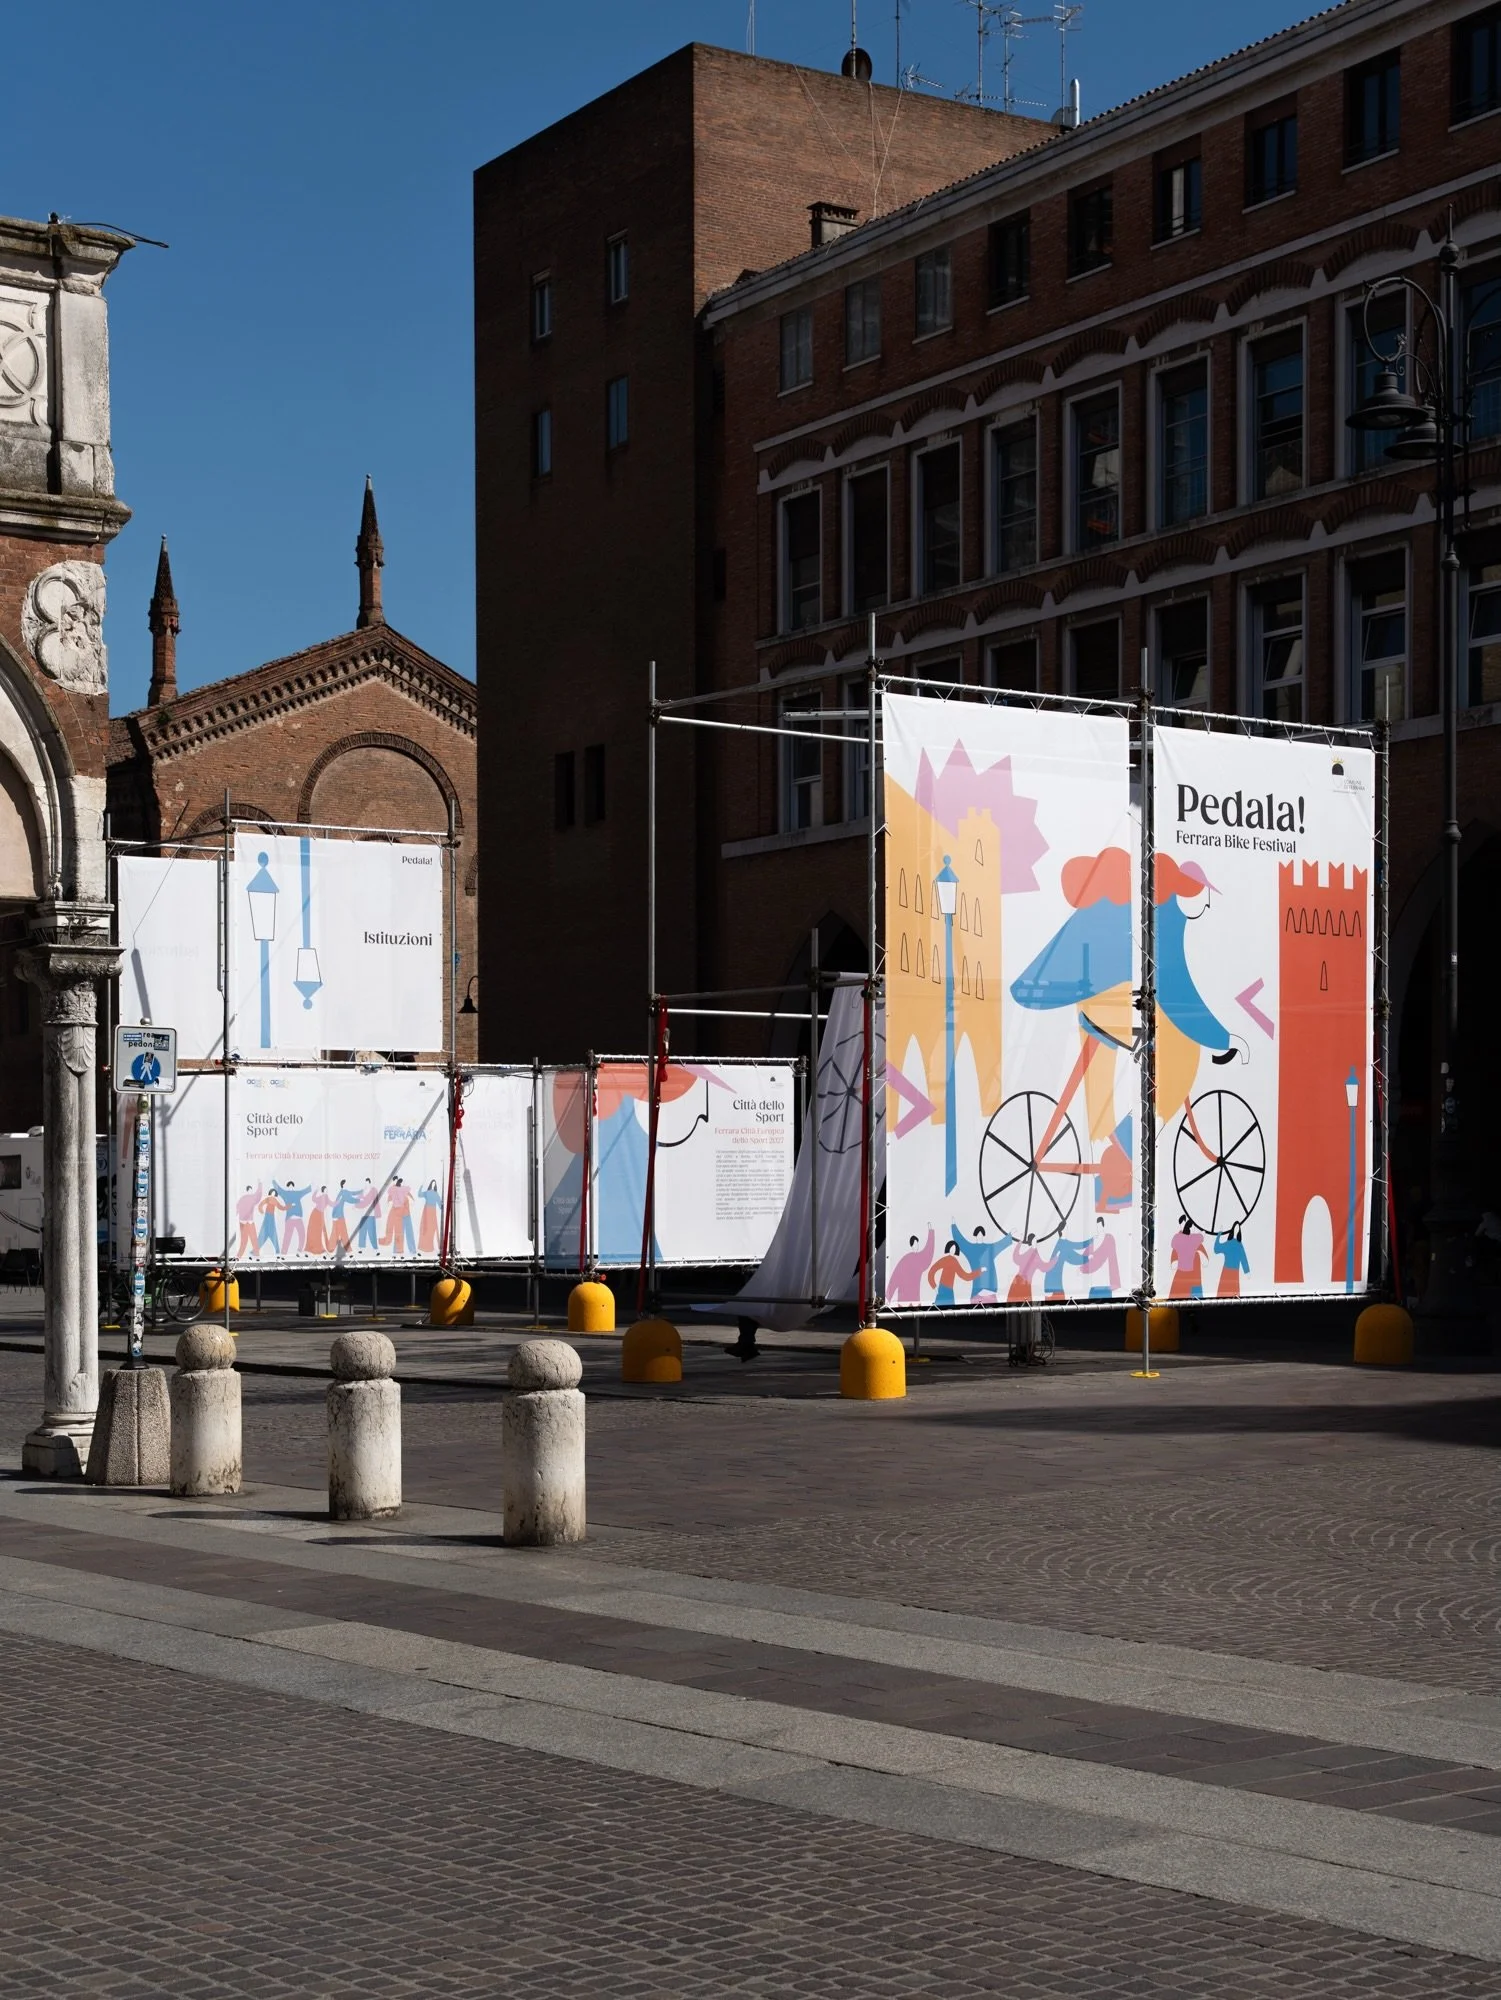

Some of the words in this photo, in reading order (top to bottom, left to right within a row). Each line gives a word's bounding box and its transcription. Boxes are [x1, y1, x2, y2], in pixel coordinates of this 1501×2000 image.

[1177, 784, 1305, 834] Pedala!
[1176, 830, 1221, 847] Ferrara
[1224, 834, 1250, 850] Bike
[1253, 837, 1296, 853] Festival
[402, 855, 433, 865] Pedala!
[364, 931, 433, 946] Istituzioni
[733, 1099, 757, 1110] Città
[759, 1100, 785, 1111] dello
[246, 1113, 272, 1124] Città
[275, 1114, 303, 1124] dello
[755, 1112, 784, 1124] Sport
[246, 1125, 278, 1138] Sport
[714, 1127, 740, 1135] Ferrara
[757, 1127, 785, 1136] Europea
[750, 1137, 768, 1145] Sport
[246, 1152, 274, 1160] Ferrara
[292, 1152, 323, 1161] Europea
[343, 1152, 363, 1161] Sport
